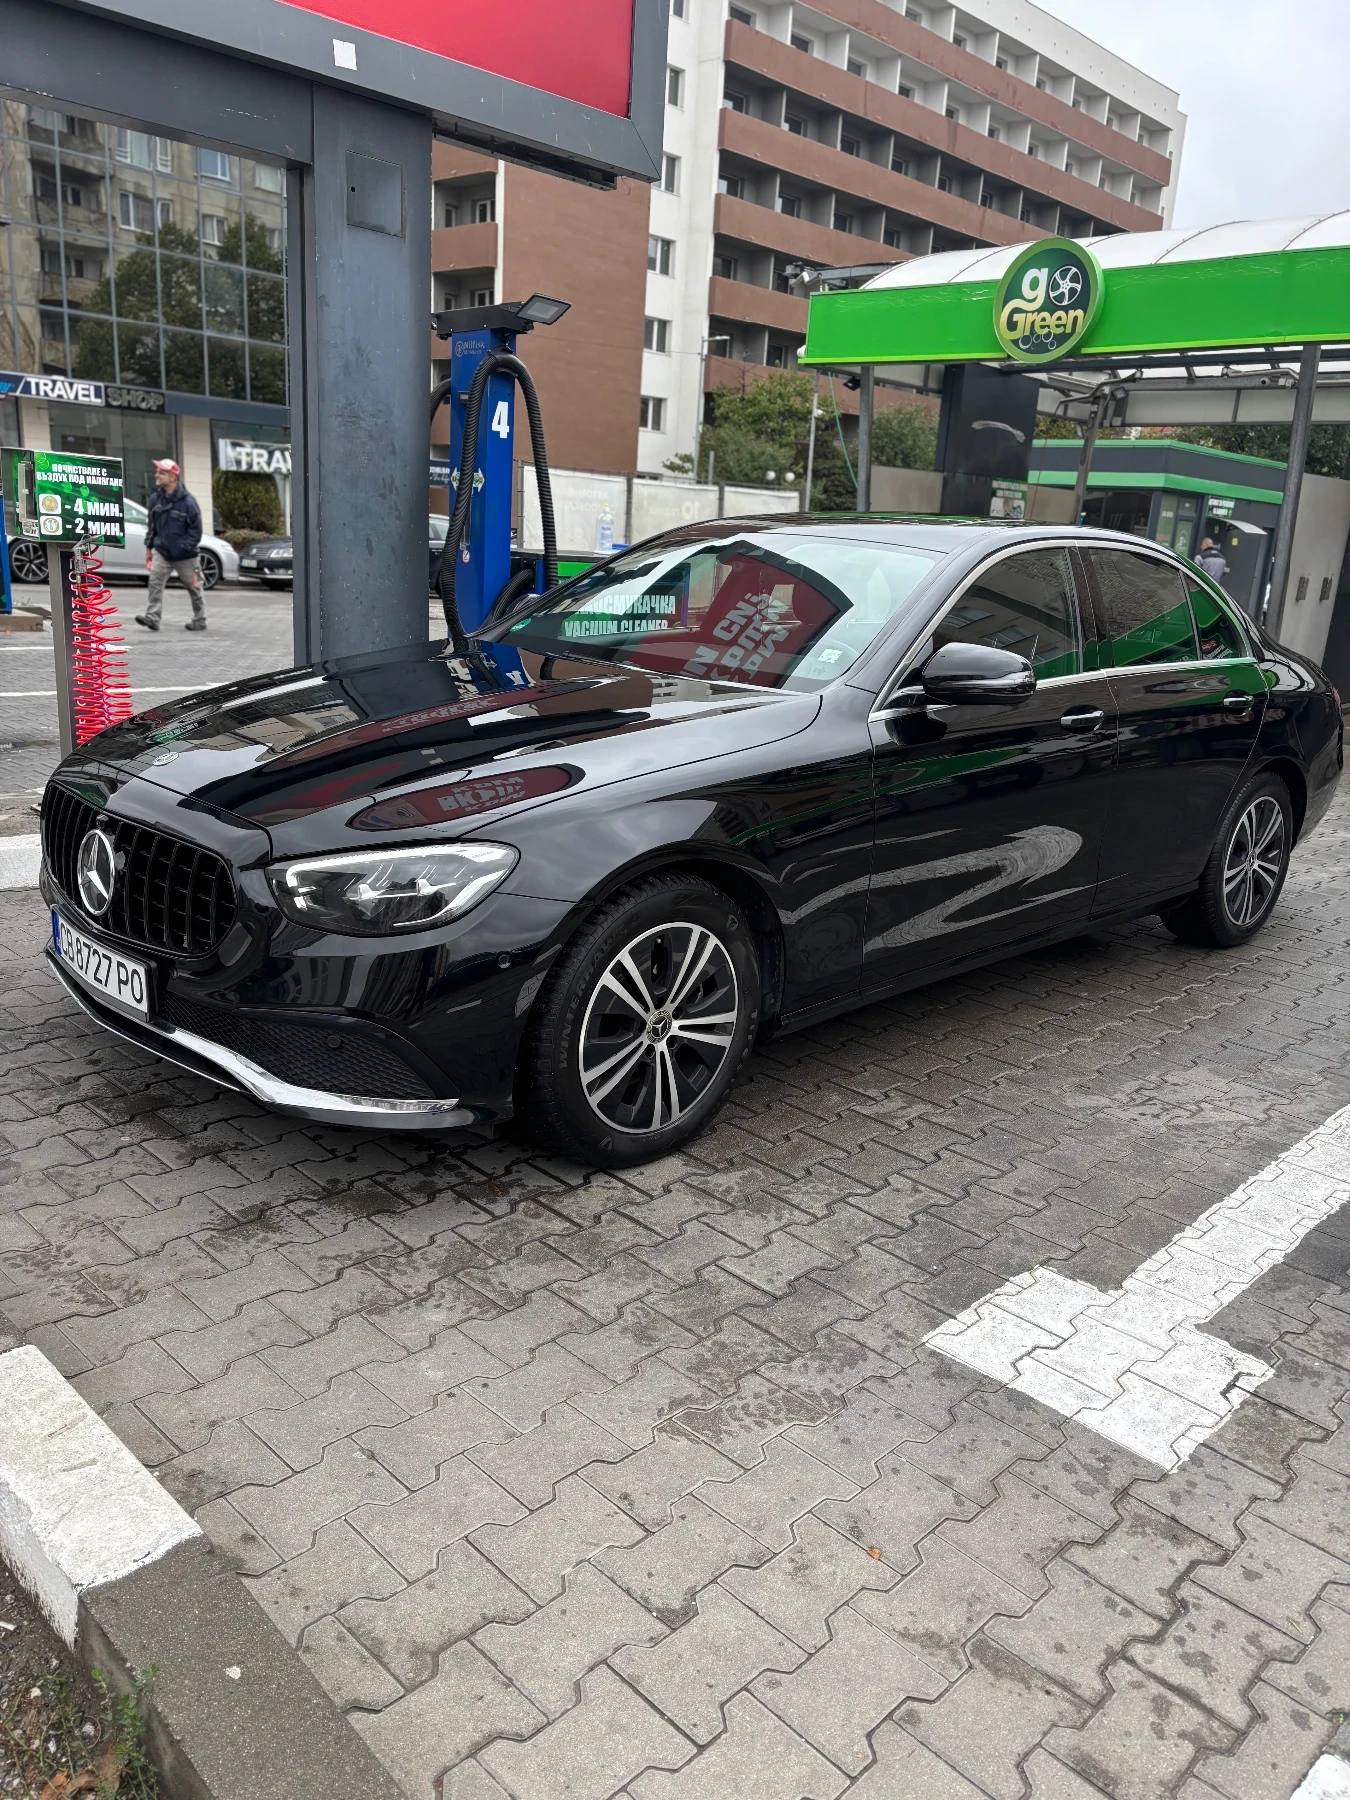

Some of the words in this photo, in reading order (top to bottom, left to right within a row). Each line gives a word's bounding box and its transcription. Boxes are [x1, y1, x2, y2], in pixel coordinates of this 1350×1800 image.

[1000, 300, 1085, 340] Green
[464, 340, 486, 349] Nilfisk
[26, 377, 102, 403] TRAVEL
[106, 387, 164, 411] SHOP
[491, 401, 509, 439] 4
[68, 475, 85, 484] ПОД
[74, 497, 84, 515] 4
[86, 501, 123, 517] МИН.
[74, 518, 85, 534] 2
[87, 521, 124, 537] МИН.
[564, 620, 618, 638] VACUUM
